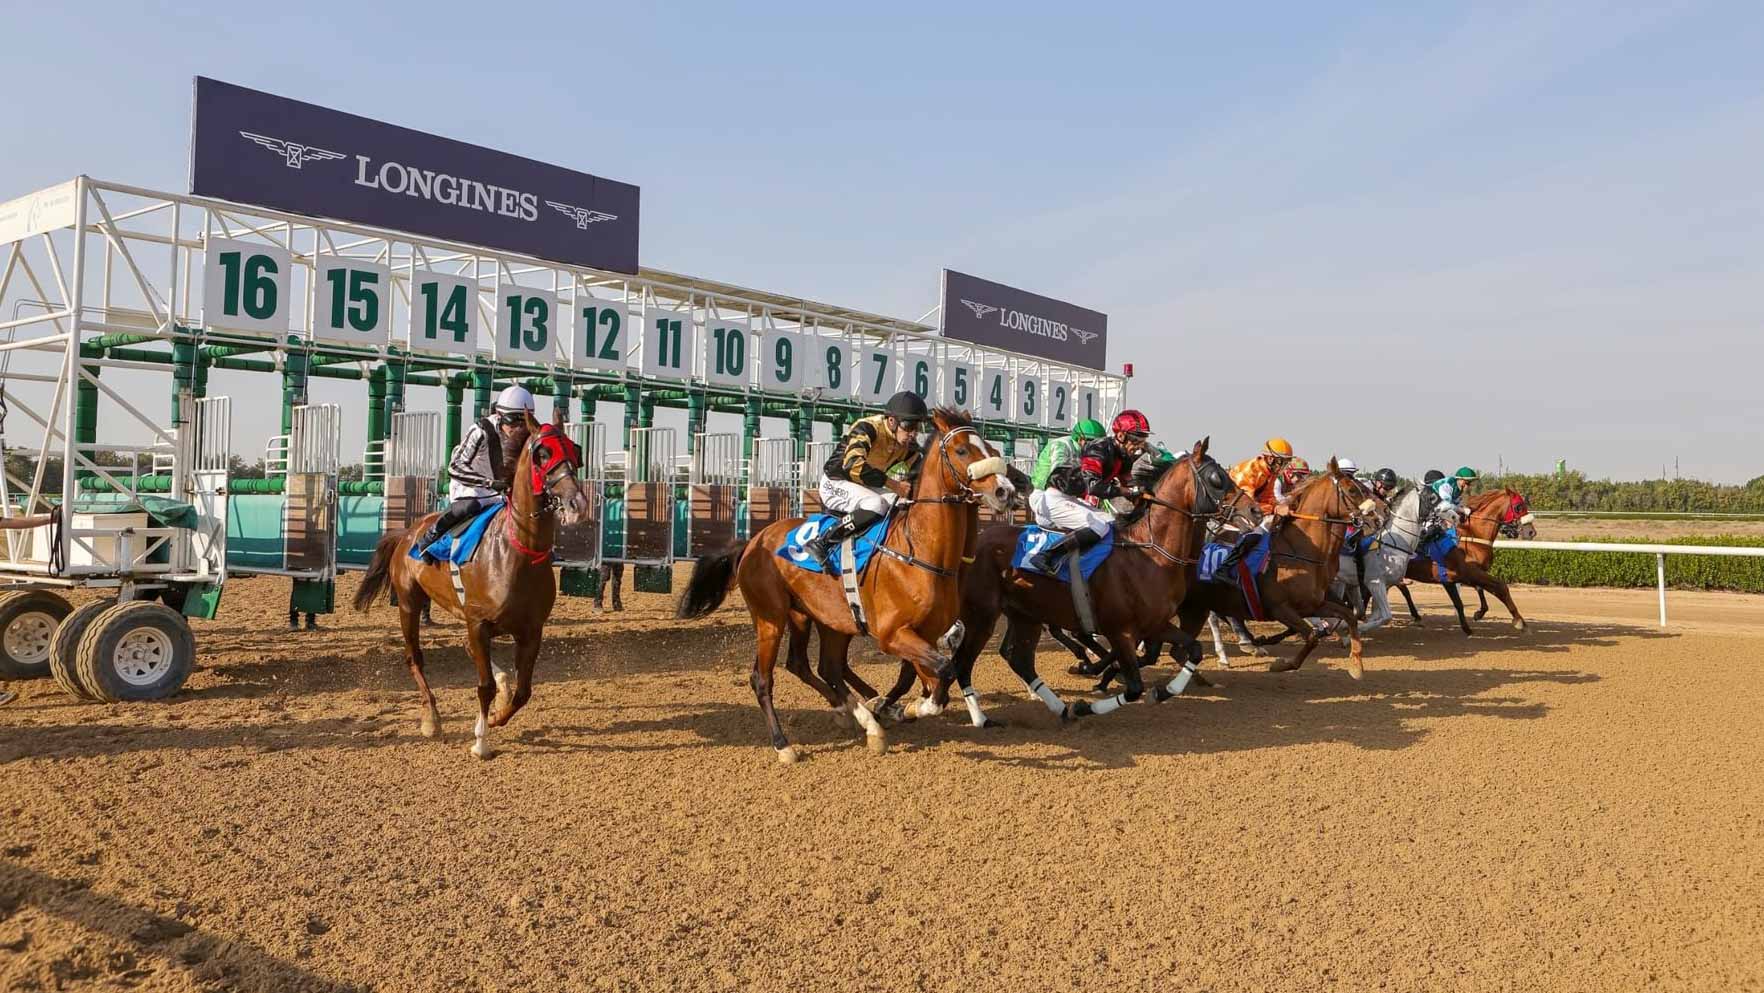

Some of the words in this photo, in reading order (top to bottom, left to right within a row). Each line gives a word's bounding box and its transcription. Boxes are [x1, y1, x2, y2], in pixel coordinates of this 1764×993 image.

[355, 154, 538, 222] LONGINES
[219, 252, 279, 319] 16
[327, 268, 379, 332] 15
[421, 281, 469, 342] 14
[507, 294, 549, 351] 13
[1000, 307, 1068, 342] LONGINES
[583, 307, 621, 360] 12
[657, 318, 682, 368] 11
[713, 327, 745, 377] 10
[775, 336, 793, 382] 9
[826, 345, 841, 389] 8
[873, 353, 888, 394] 7
[915, 361, 928, 400] 6
[954, 367, 967, 405] 5
[990, 374, 1002, 411] 4
[1024, 380, 1035, 415] 3
[1055, 386, 1065, 420] 2
[1086, 393, 1092, 420] 1
[788, 520, 819, 561] 9
[1200, 548, 1228, 580] 10
